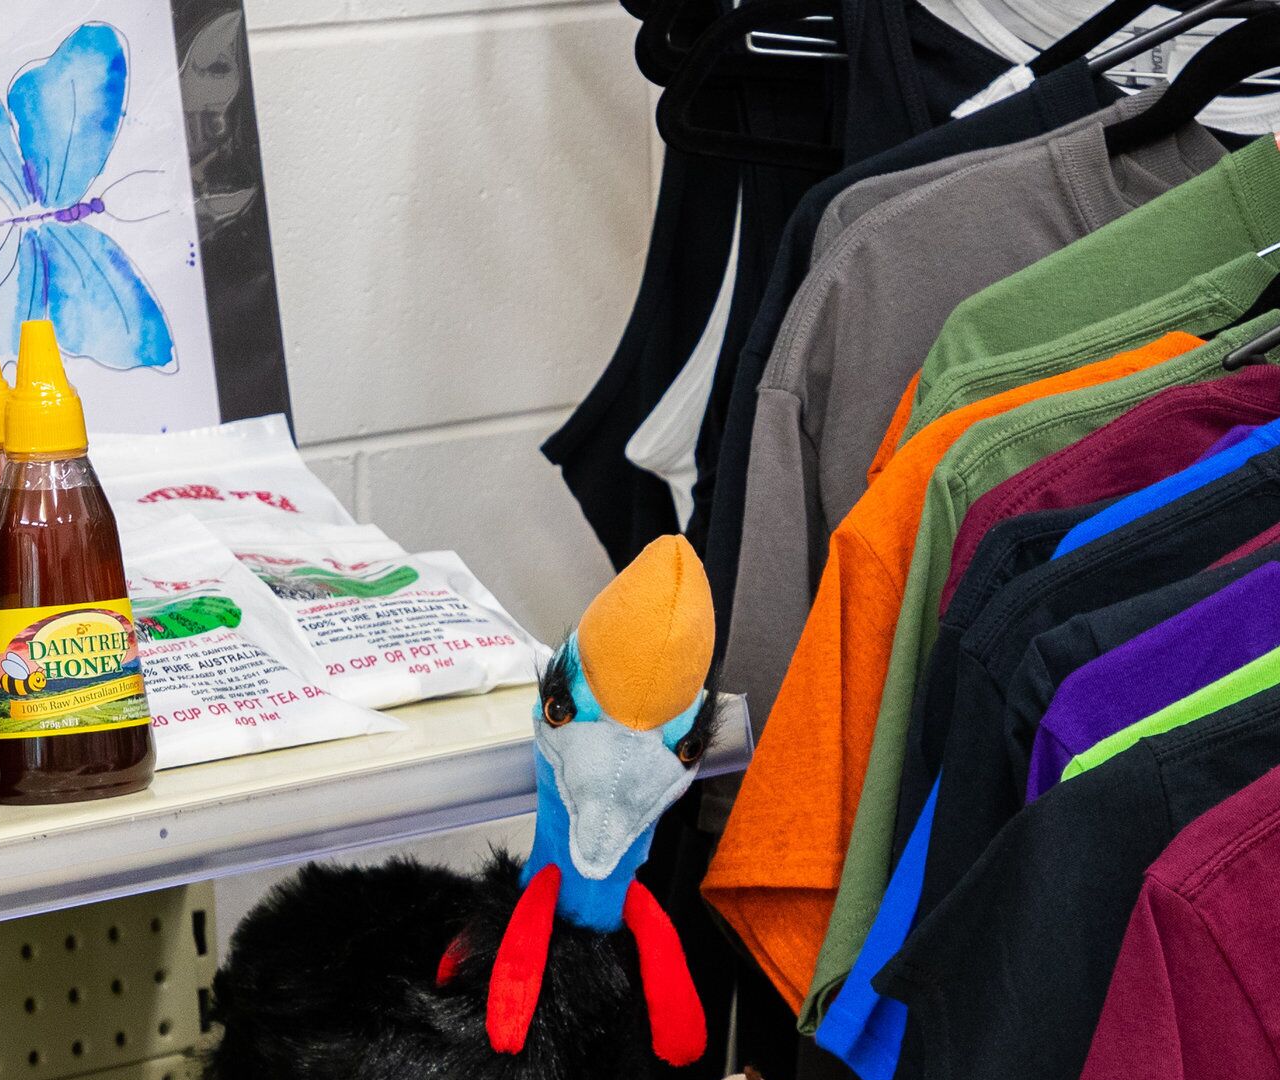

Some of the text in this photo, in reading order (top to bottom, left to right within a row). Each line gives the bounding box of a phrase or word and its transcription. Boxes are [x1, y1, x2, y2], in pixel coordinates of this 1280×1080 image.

[302, 620, 335, 631] 100%
[340, 613, 371, 622] PURE
[376, 604, 444, 618] AUSTRALIAN
[28, 632, 131, 661] DAINTREE
[145, 657, 169, 666] HEART
[202, 645, 238, 656] DAINTREE
[326, 634, 516, 676] 20 CUP OR POT TEA BAGS
[45, 653, 124, 679] HONEY
[162, 663, 193, 674] PURE
[408, 657, 455, 675] 40g Net
[21, 679, 140, 714] 100% Raw Australian Honey
[152, 685, 329, 728] 20 CUP OR POT TEA BA
[235, 712, 281, 726] 40g Net
